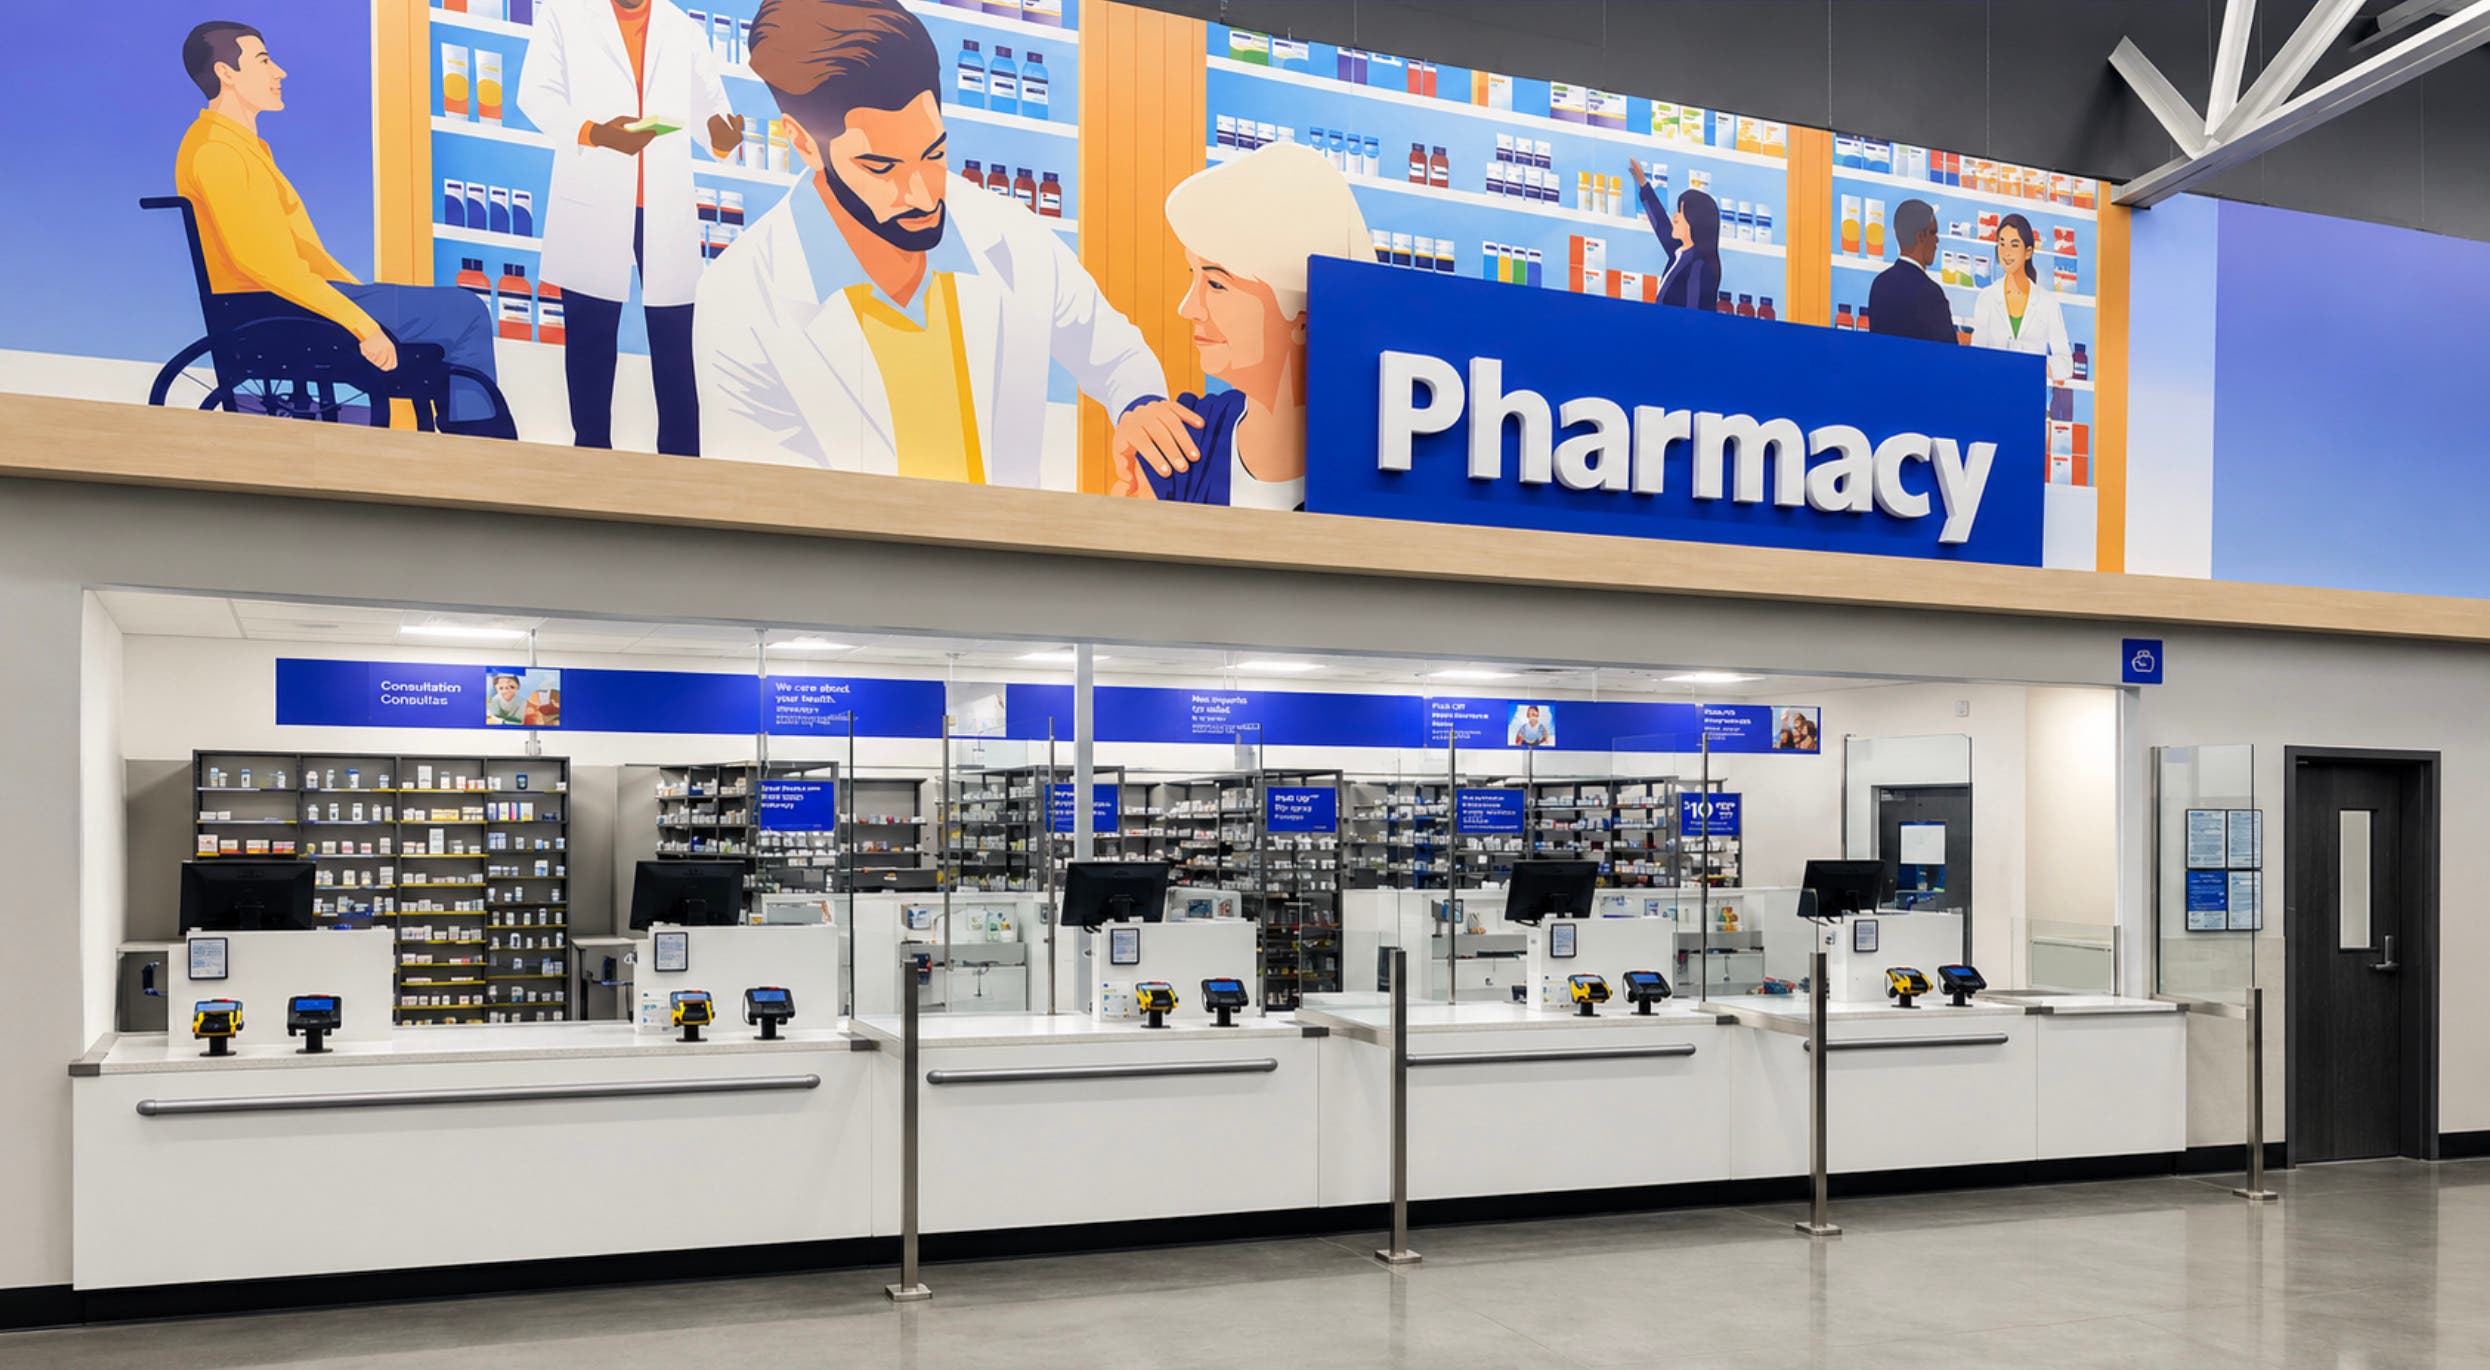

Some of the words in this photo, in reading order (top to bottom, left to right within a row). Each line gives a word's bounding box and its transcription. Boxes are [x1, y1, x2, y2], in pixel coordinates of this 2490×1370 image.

[1378, 350, 1998, 545] Pharmacy
[380, 680, 462, 693] Consultation
[380, 693, 449, 706] Consultas
